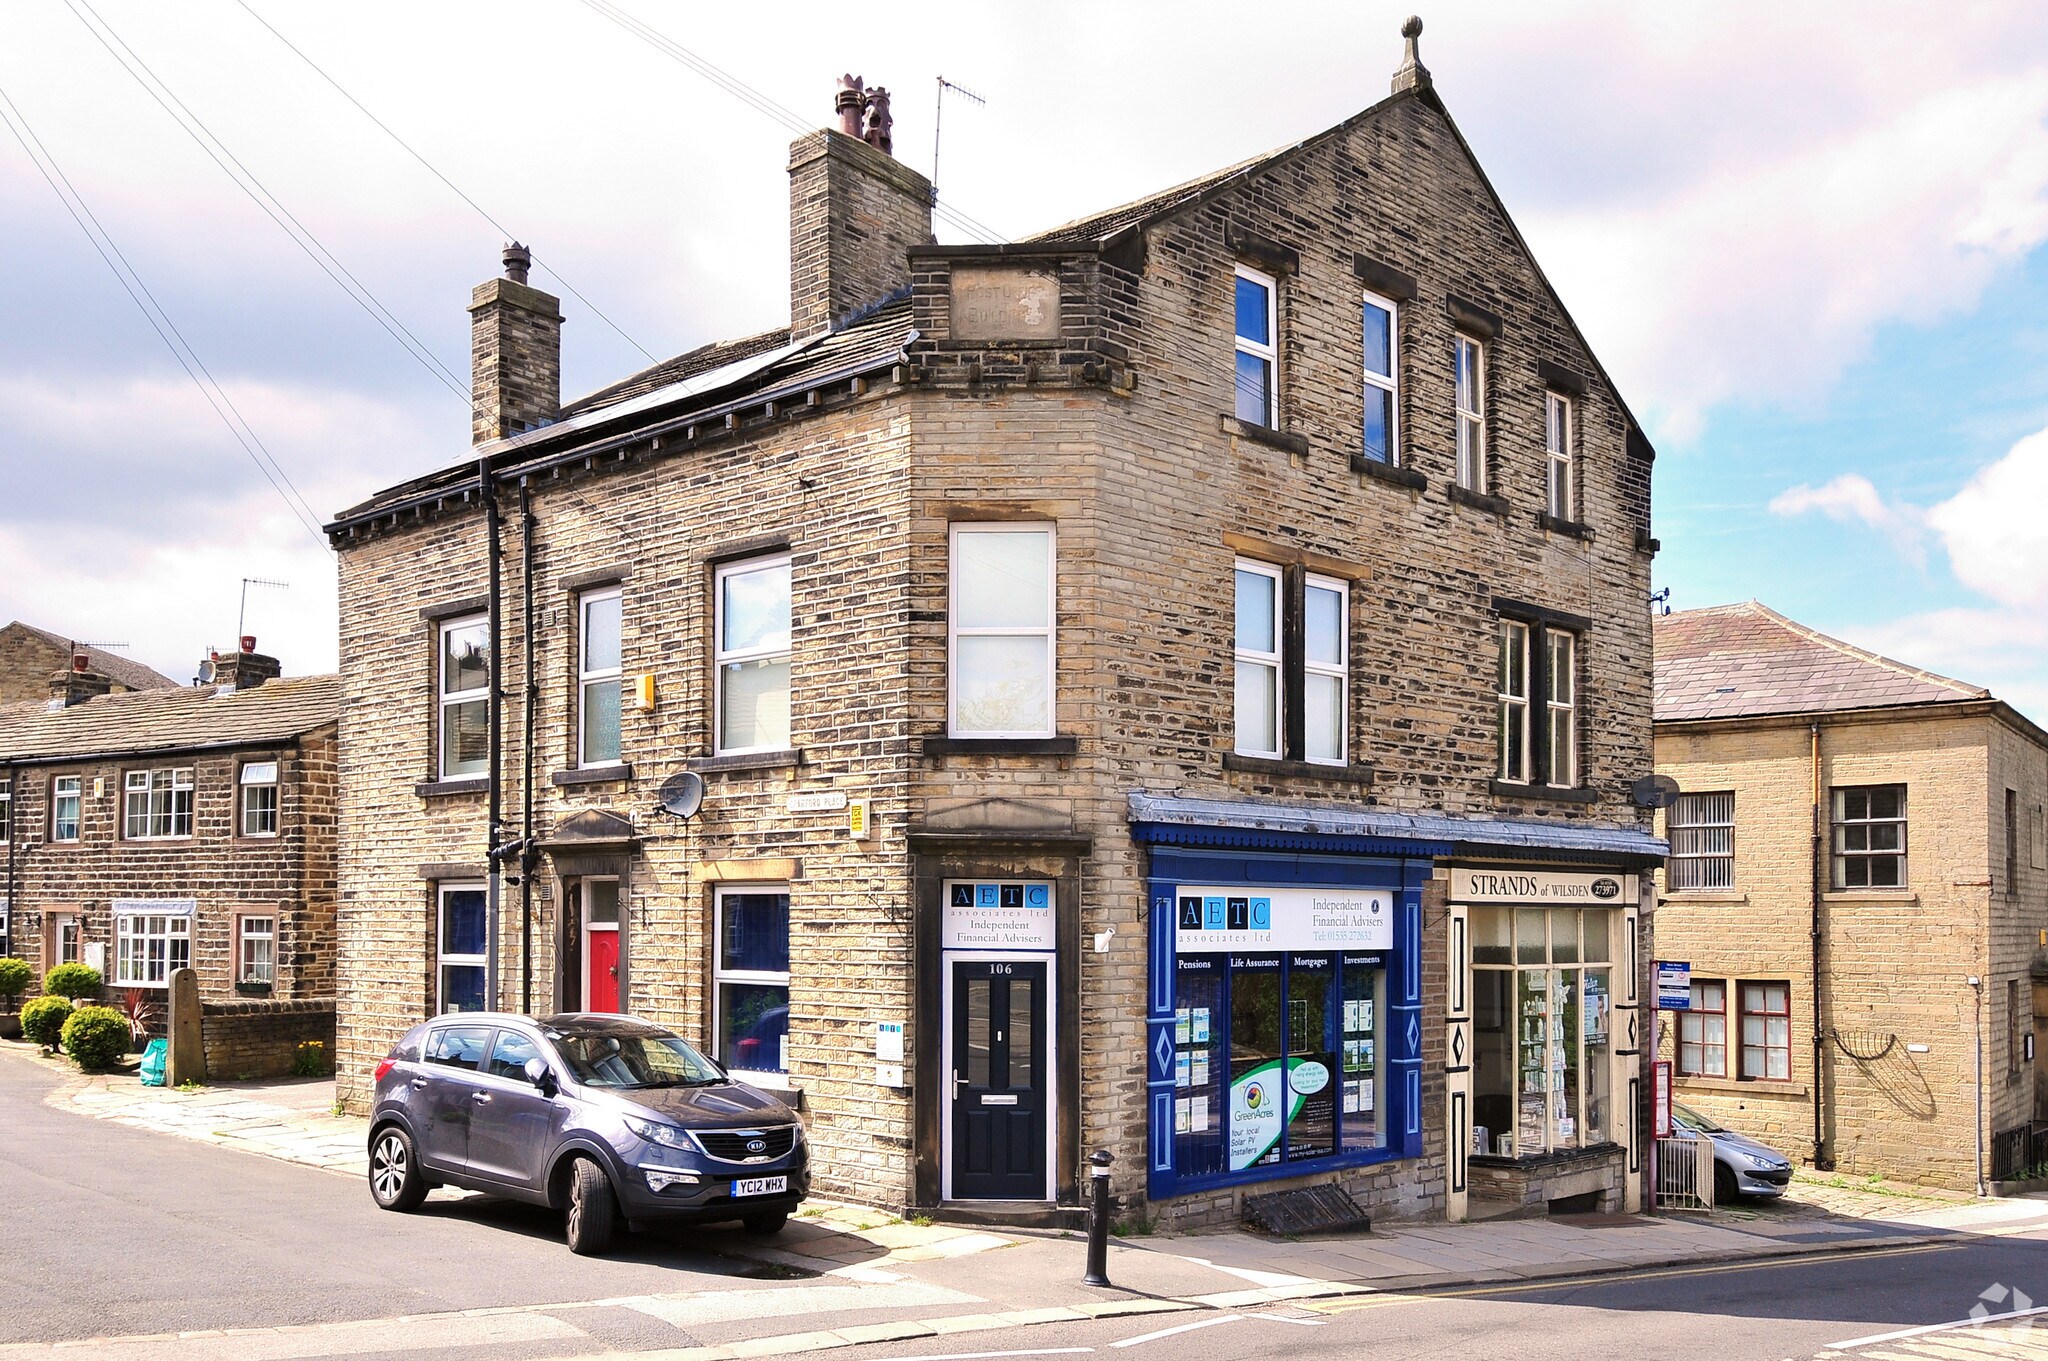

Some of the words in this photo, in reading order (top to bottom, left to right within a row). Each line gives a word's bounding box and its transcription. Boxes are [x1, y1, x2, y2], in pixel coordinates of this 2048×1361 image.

[824, 796, 844, 807] PLACE
[1470, 874, 1537, 896] STRANDS
[1541, 884, 1549, 896] of
[1552, 884, 1590, 897] WILSDEN
[955, 887, 1043, 905] AETC
[1312, 898, 1363, 914] Independent
[950, 909, 1021, 917] associates
[1029, 909, 1048, 918] ltd
[1182, 900, 1266, 925] AETC
[970, 920, 1030, 932] Independent
[1312, 915, 1349, 927] Financial
[1350, 915, 1384, 927] Advisers
[957, 932, 999, 943] Financial
[1001, 933, 1042, 943] Advisers
[1178, 932, 1247, 943] associates
[1254, 931, 1271, 942] ltd
[1327, 931, 1348, 941] 01535
[1178, 959, 1211, 969] Pensions
[1230, 958, 1244, 968] Life
[1245, 958, 1280, 968] Assurance
[1294, 957, 1327, 968] Mortgages
[1344, 956, 1380, 965] Investments
[989, 963, 1013, 975] 106
[1234, 1109, 1274, 1122] GreenAcres
[1231, 1129, 1244, 1137] Your
[1246, 1126, 1260, 1135] local
[1231, 1138, 1246, 1147] Solar
[1248, 1137, 1256, 1145] PV
[1230, 1146, 1258, 1157] Installers
[740, 1180, 763, 1194] YC12
[765, 1177, 784, 1191] WHX
